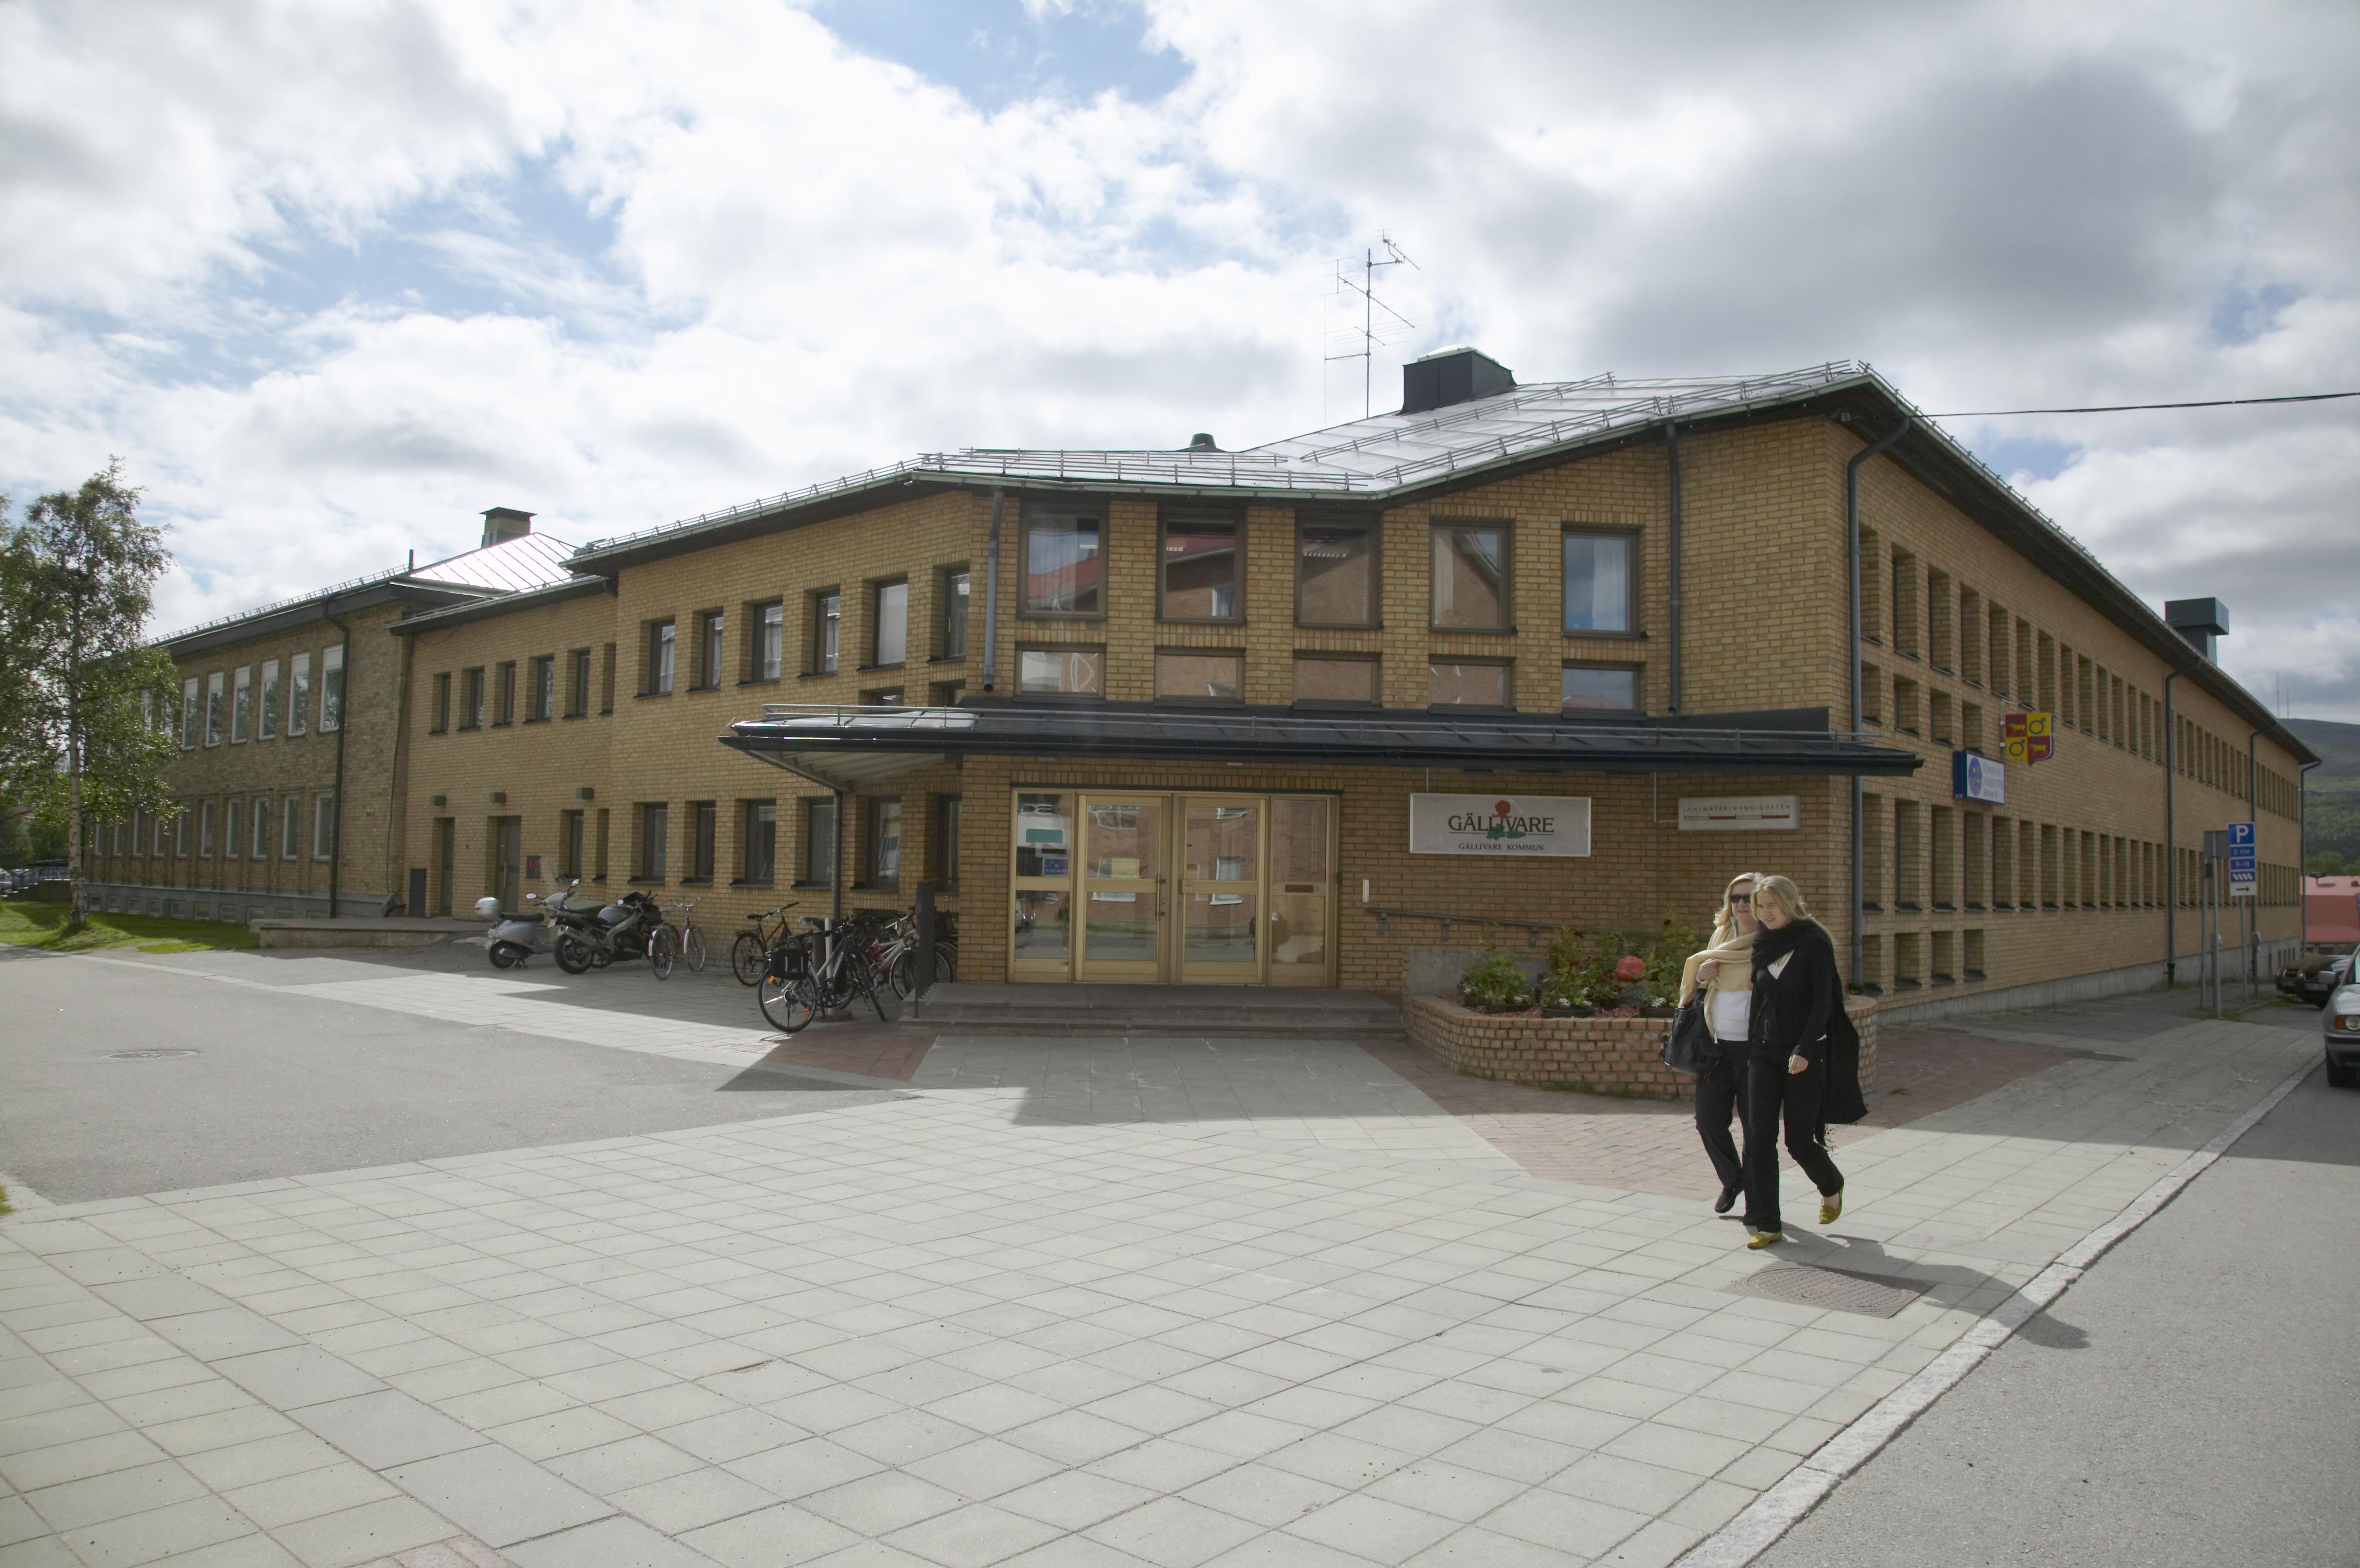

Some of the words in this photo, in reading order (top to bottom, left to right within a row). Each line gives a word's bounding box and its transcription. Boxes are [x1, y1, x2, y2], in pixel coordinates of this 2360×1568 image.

[1448, 812, 1555, 832] GÄLLIVARE
[2236, 825, 2249, 843] P
[1459, 843, 1503, 851] GÄLLIVARE
